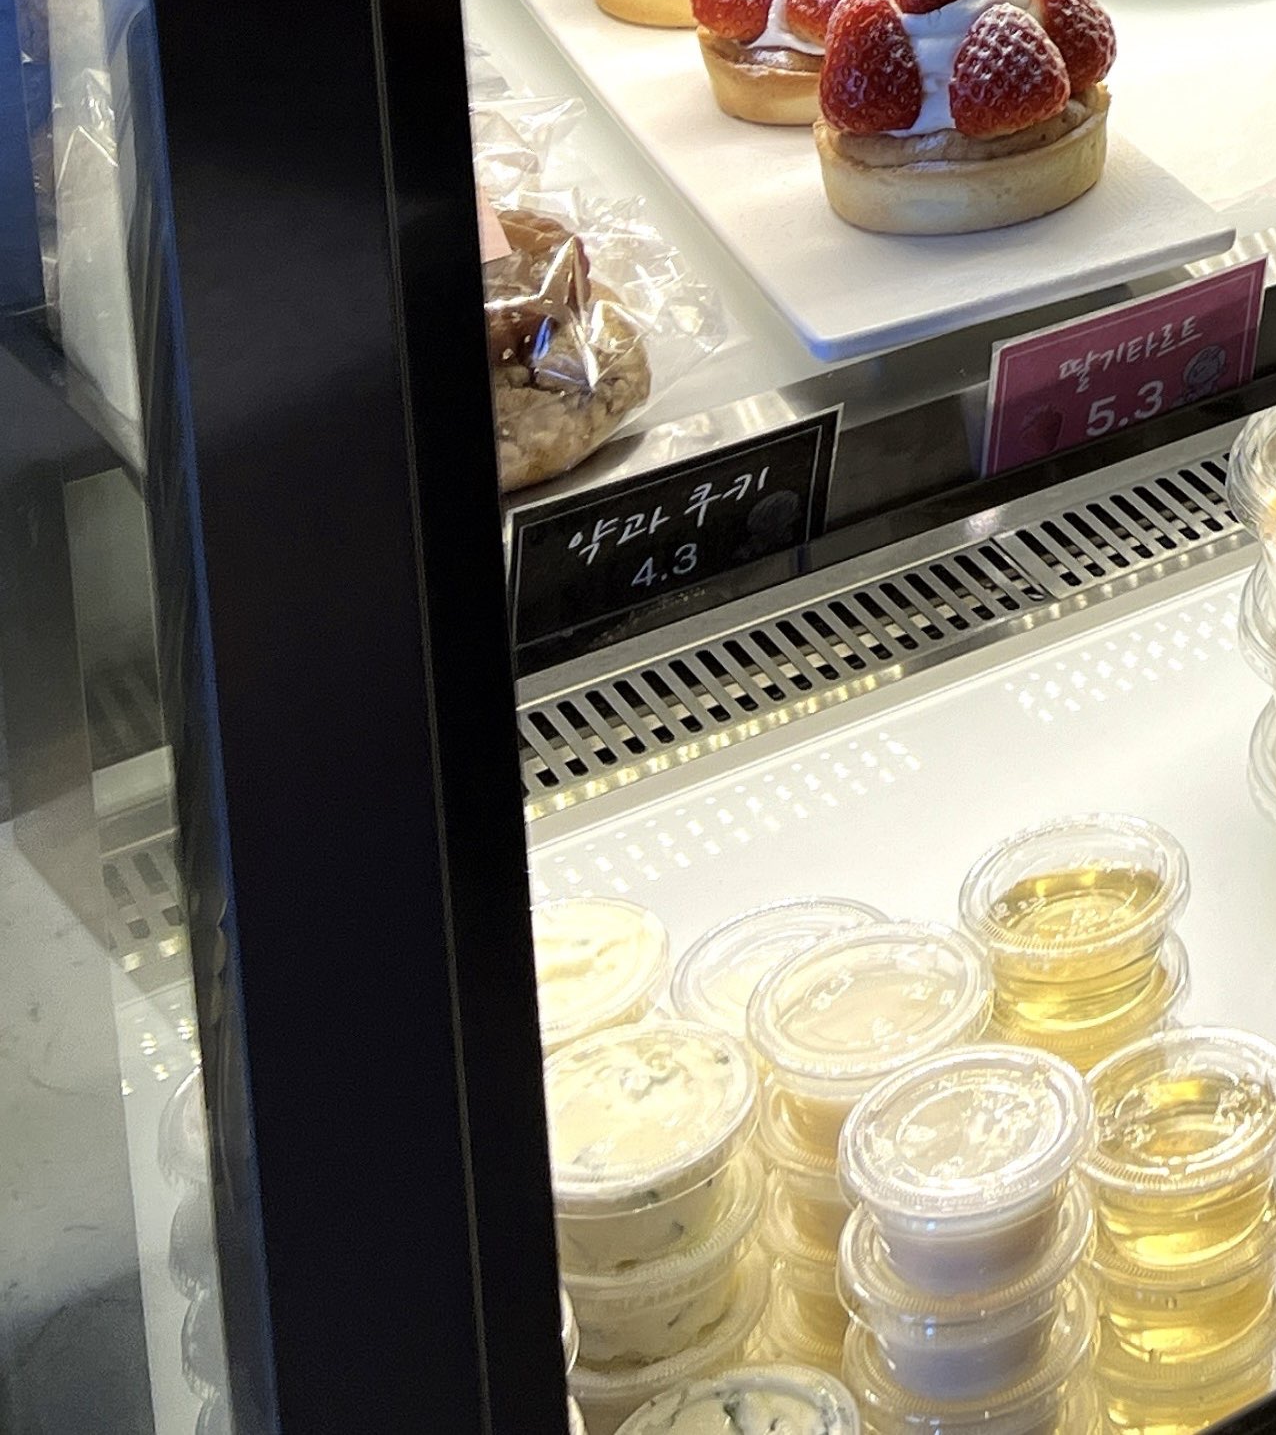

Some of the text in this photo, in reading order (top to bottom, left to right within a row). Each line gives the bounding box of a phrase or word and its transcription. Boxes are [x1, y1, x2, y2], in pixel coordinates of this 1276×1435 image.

[1086, 380, 1164, 436] 5.3
[568, 466, 770, 565] 약과 쿠키
[631, 543, 698, 587] 4.3
